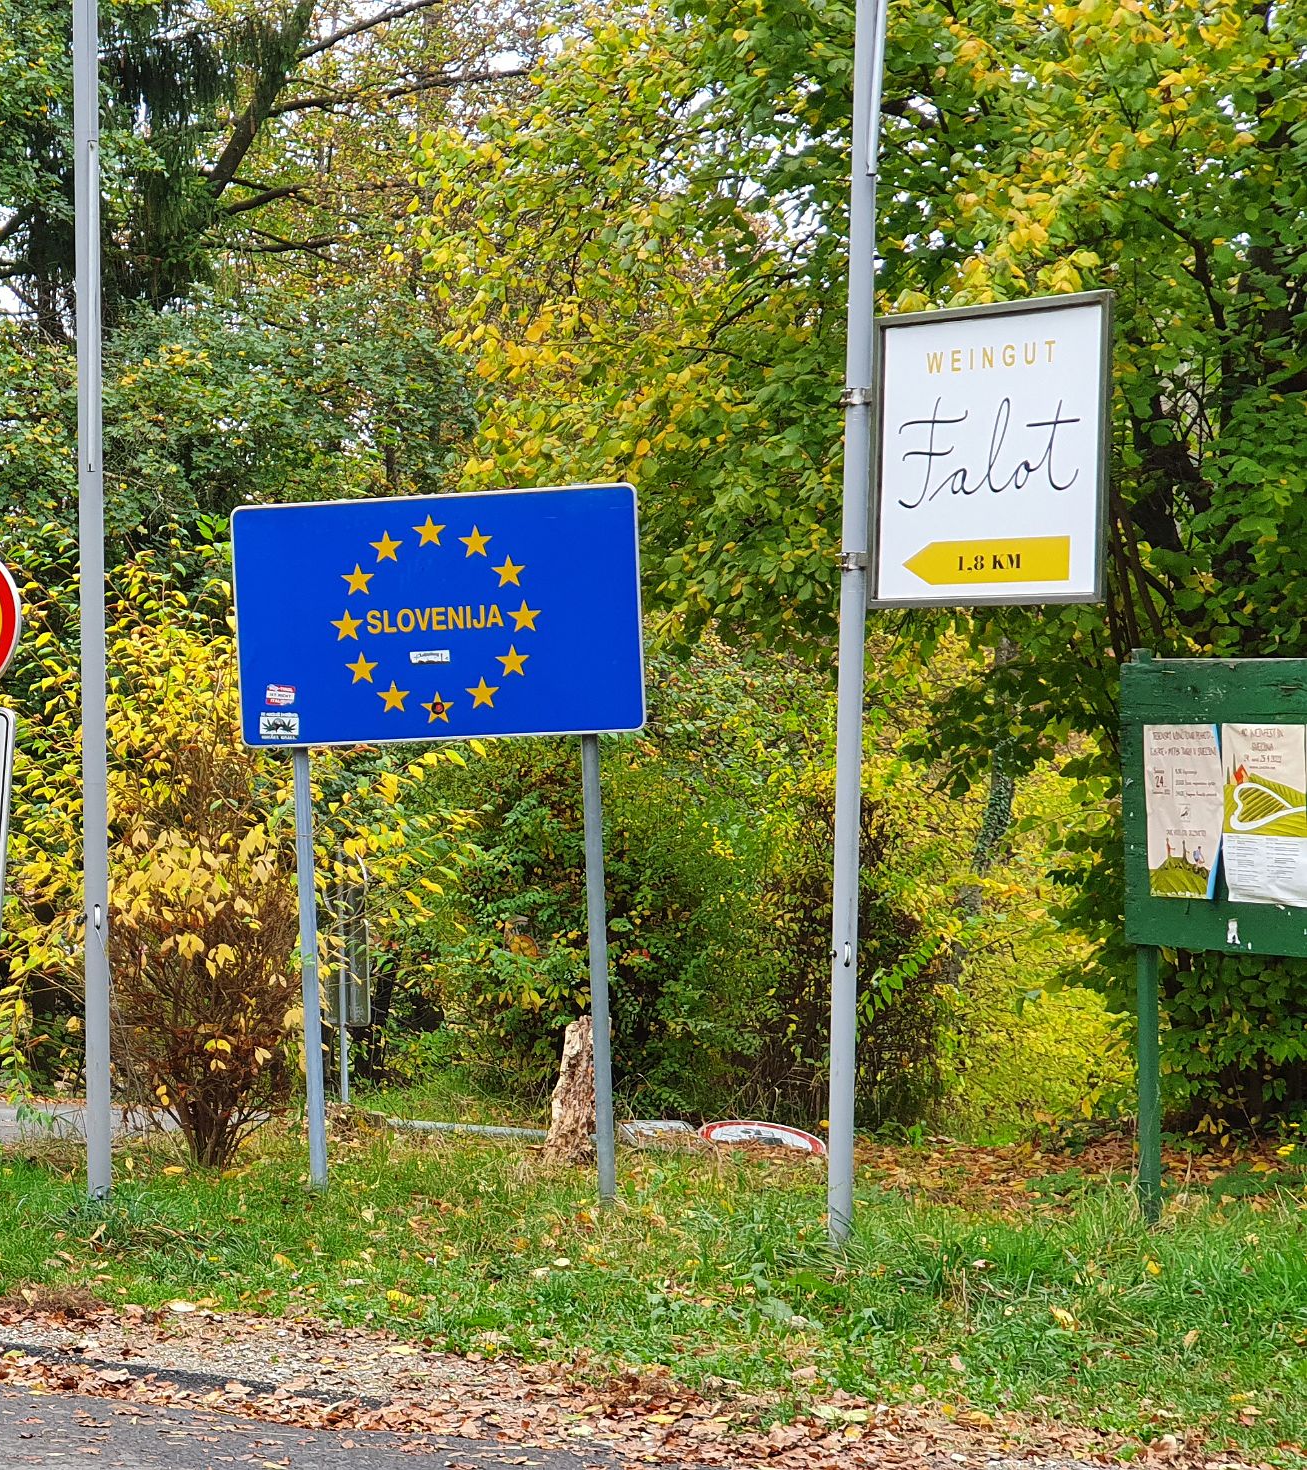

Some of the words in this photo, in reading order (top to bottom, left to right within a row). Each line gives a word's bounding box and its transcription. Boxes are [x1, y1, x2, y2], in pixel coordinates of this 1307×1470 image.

[926, 339, 1057, 375] WEINGUT
[898, 396, 1080, 509] Falot
[991, 552, 1021, 570] KM
[366, 603, 504, 635] SLOVENIJA
